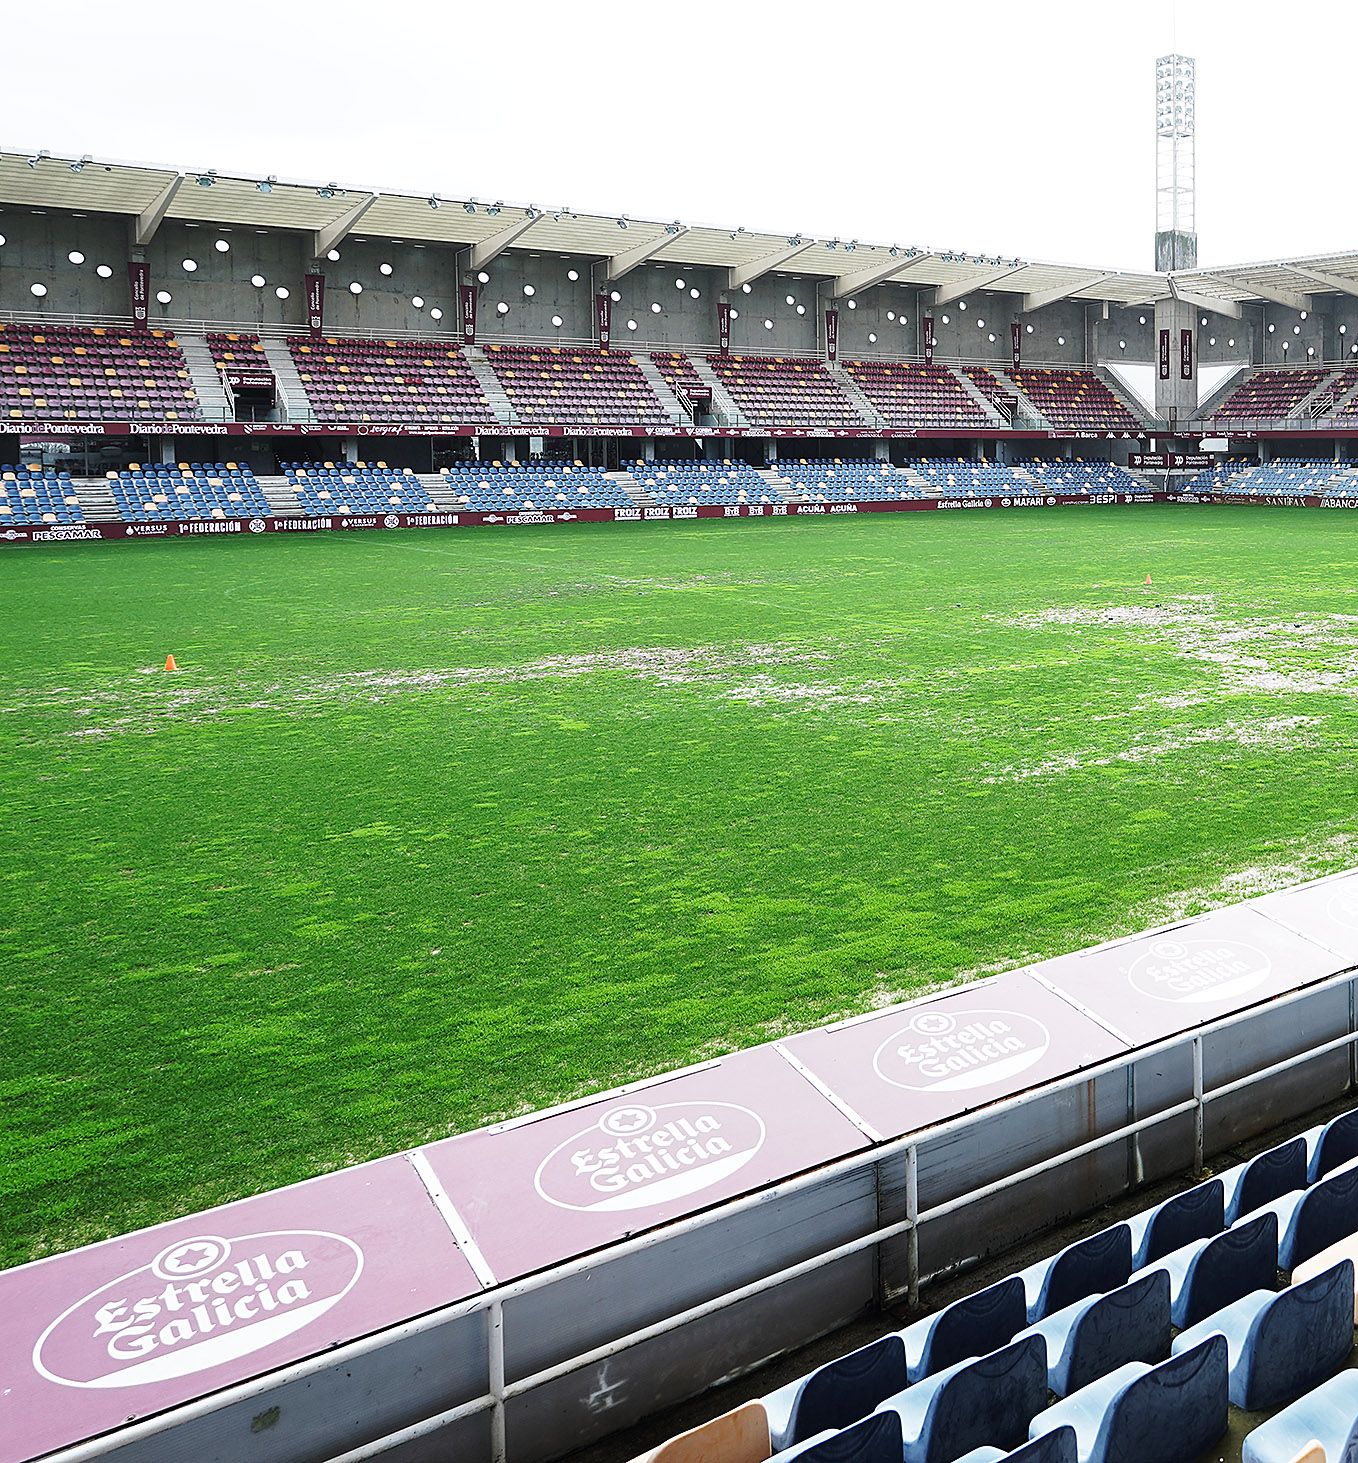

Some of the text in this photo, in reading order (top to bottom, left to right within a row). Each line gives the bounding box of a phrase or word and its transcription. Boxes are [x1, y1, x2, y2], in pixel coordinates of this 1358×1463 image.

[830, 503, 858, 512] ACUÑA
[1013, 497, 1044, 506] MAFARI
[615, 508, 642, 517] FROIZ
[644, 507, 670, 516] FROIZ
[672, 506, 698, 515] FROIZ
[797, 504, 825, 513] ACUÑA
[506, 514, 555, 524] PESCAMAR
[32, 528, 103, 541] PESCAMAR
[1146, 948, 1236, 982] Estrella
[897, 1019, 1012, 1065] Estrella
[919, 1036, 1026, 1078] Galicia
[570, 1115, 722, 1177] Estrella
[590, 1136, 733, 1192] Galicia
[93, 1250, 311, 1337] Estrella
[107, 1279, 313, 1360] Galicia
